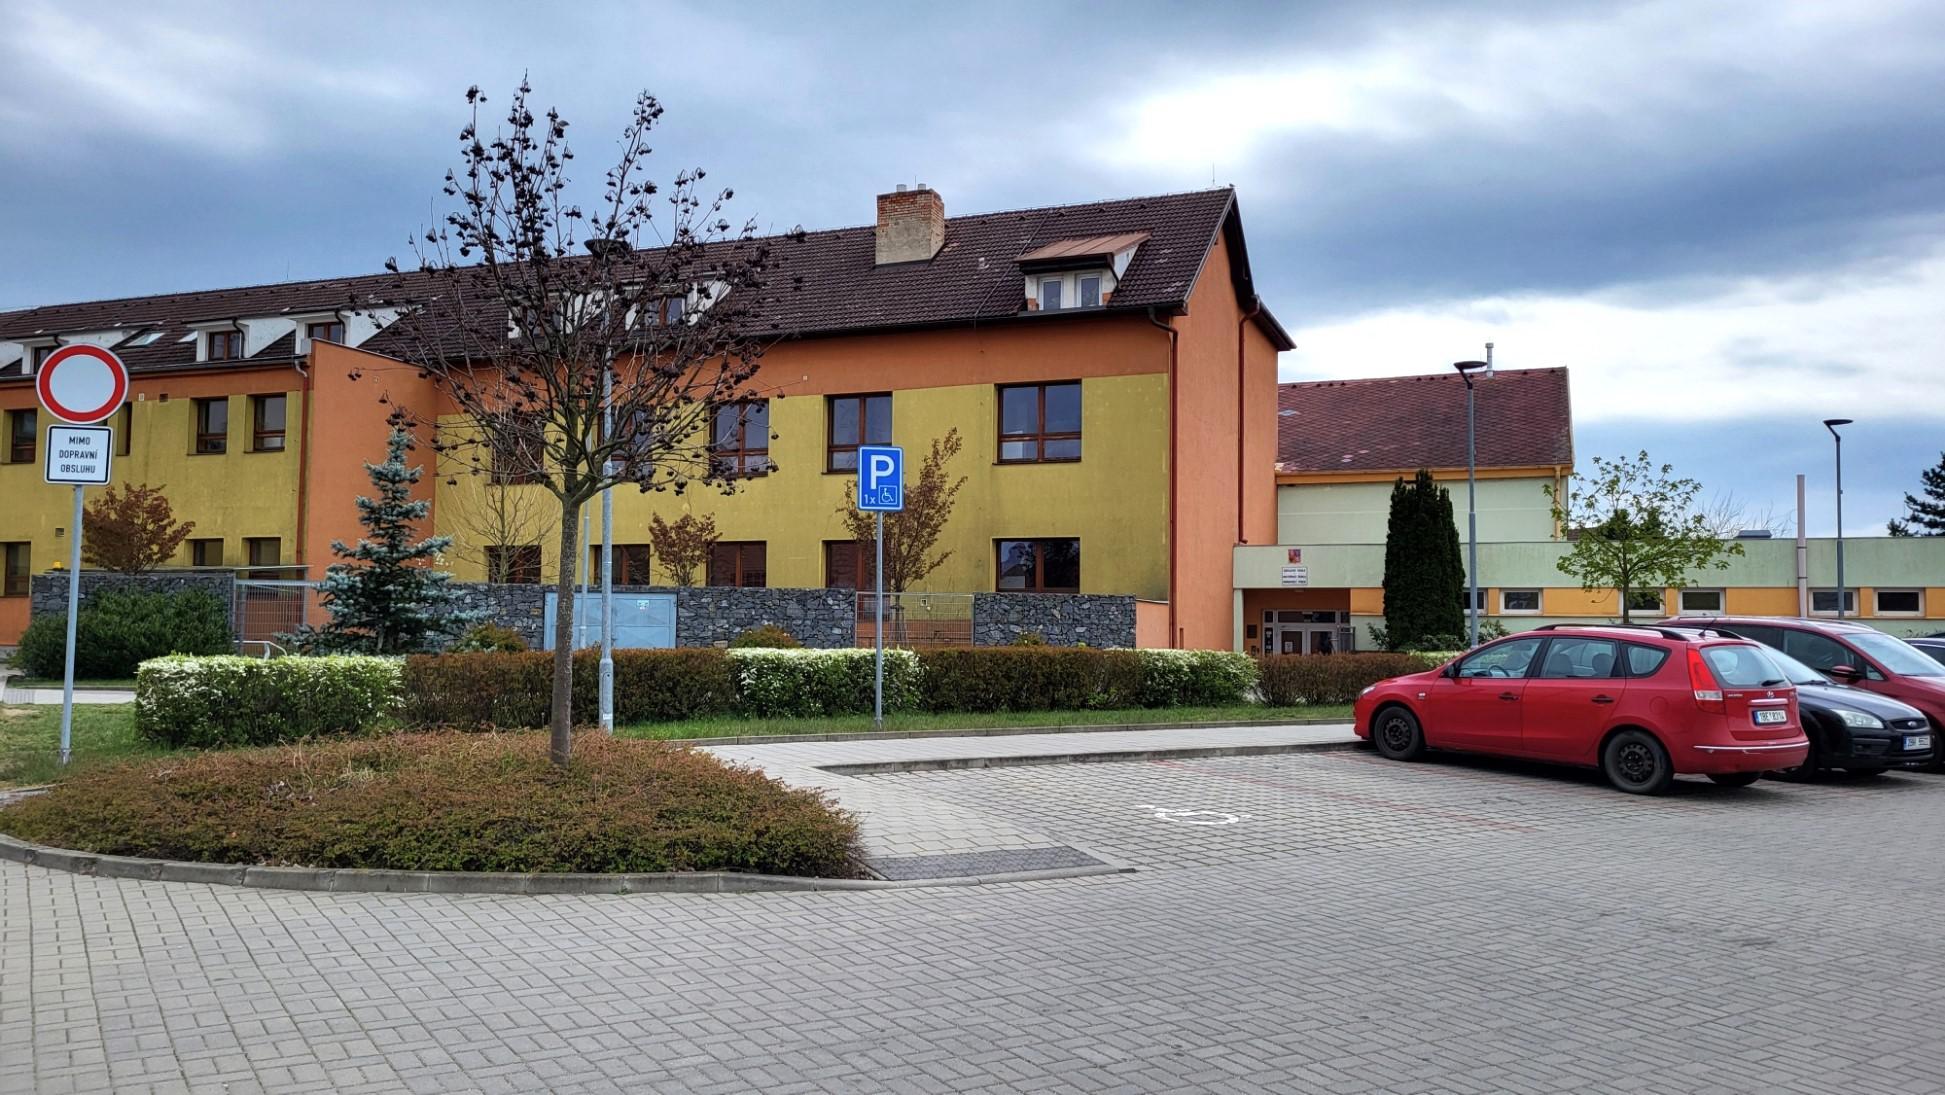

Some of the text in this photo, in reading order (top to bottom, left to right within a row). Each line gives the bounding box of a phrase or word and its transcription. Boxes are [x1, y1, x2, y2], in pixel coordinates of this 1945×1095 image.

[69, 436, 91, 445] MIMO
[59, 449, 98, 459] DOPRAVNÍ
[60, 464, 96, 473] OBSLUHU
[871, 454, 895, 490] P
